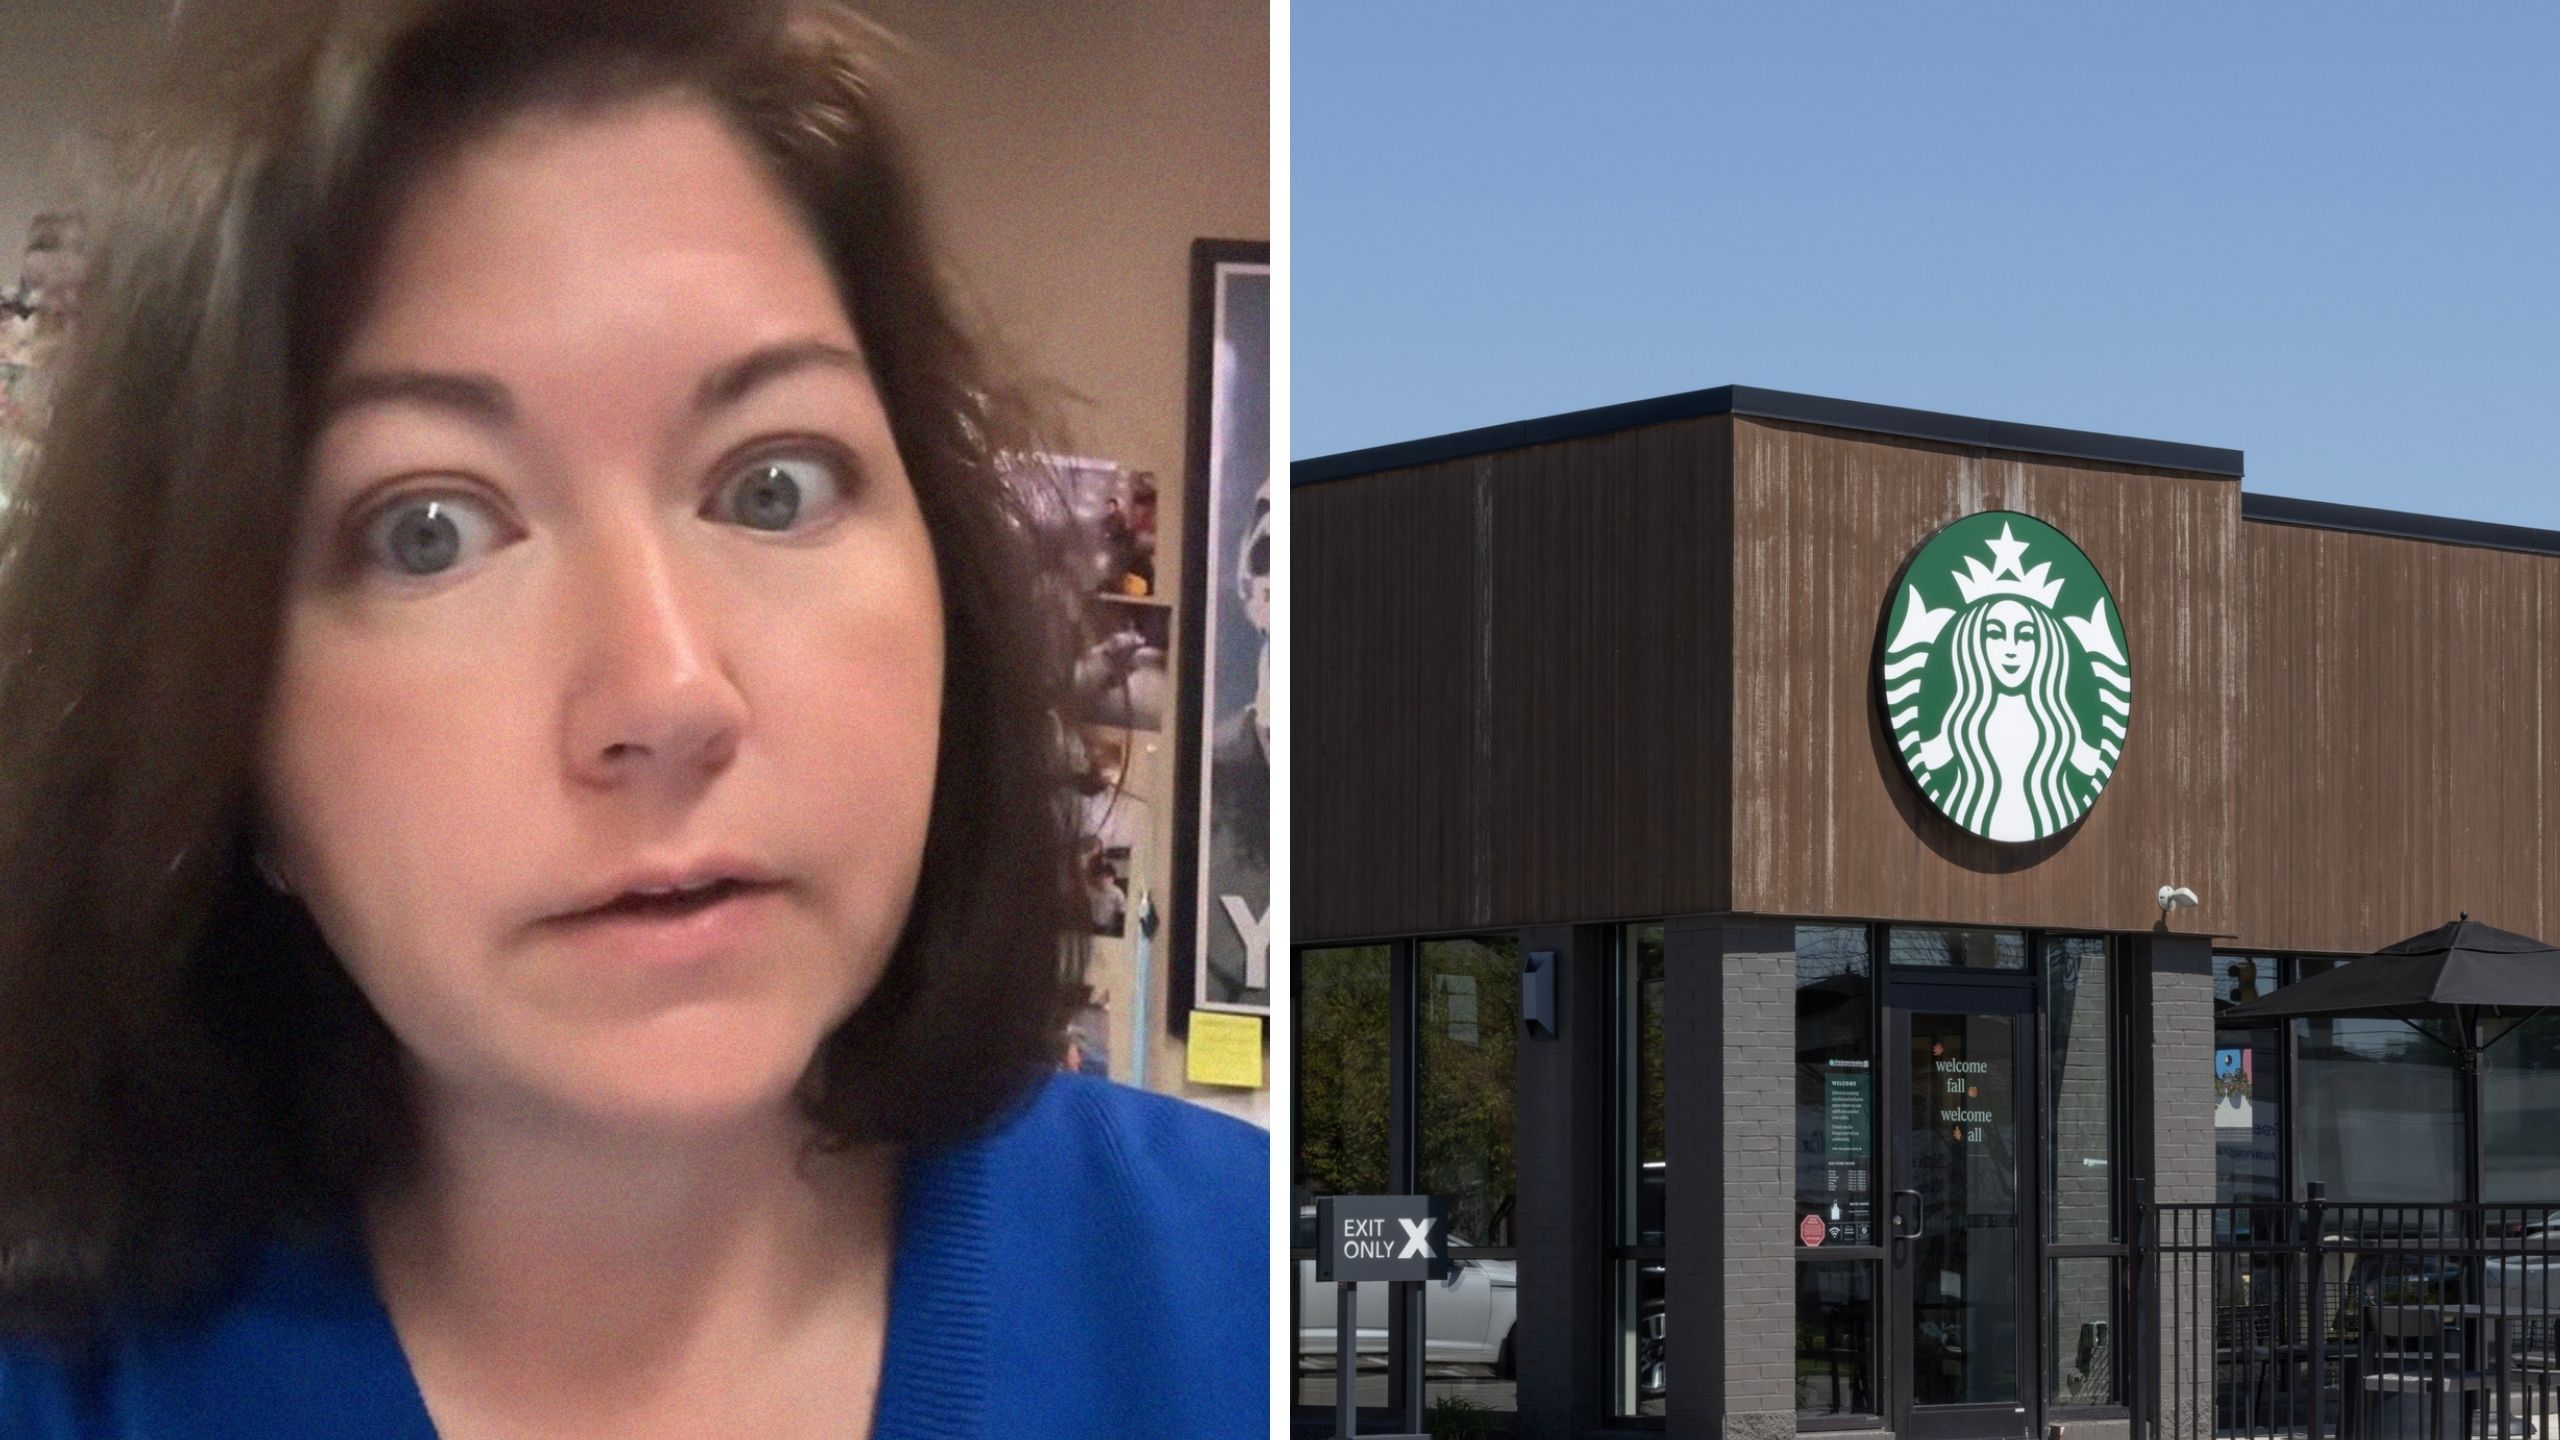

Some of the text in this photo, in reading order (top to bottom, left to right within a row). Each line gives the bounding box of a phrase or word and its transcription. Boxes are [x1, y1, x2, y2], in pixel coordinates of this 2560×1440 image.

[1220, 895, 1270, 989] Y
[1936, 1057, 1988, 1073] welcome
[1946, 1078, 1966, 1093] fall
[1941, 1106, 1993, 1122] welcome
[1967, 1127, 1983, 1142] all
[1344, 1219, 1385, 1237] EXIT
[1344, 1240, 1395, 1259] ONLY
